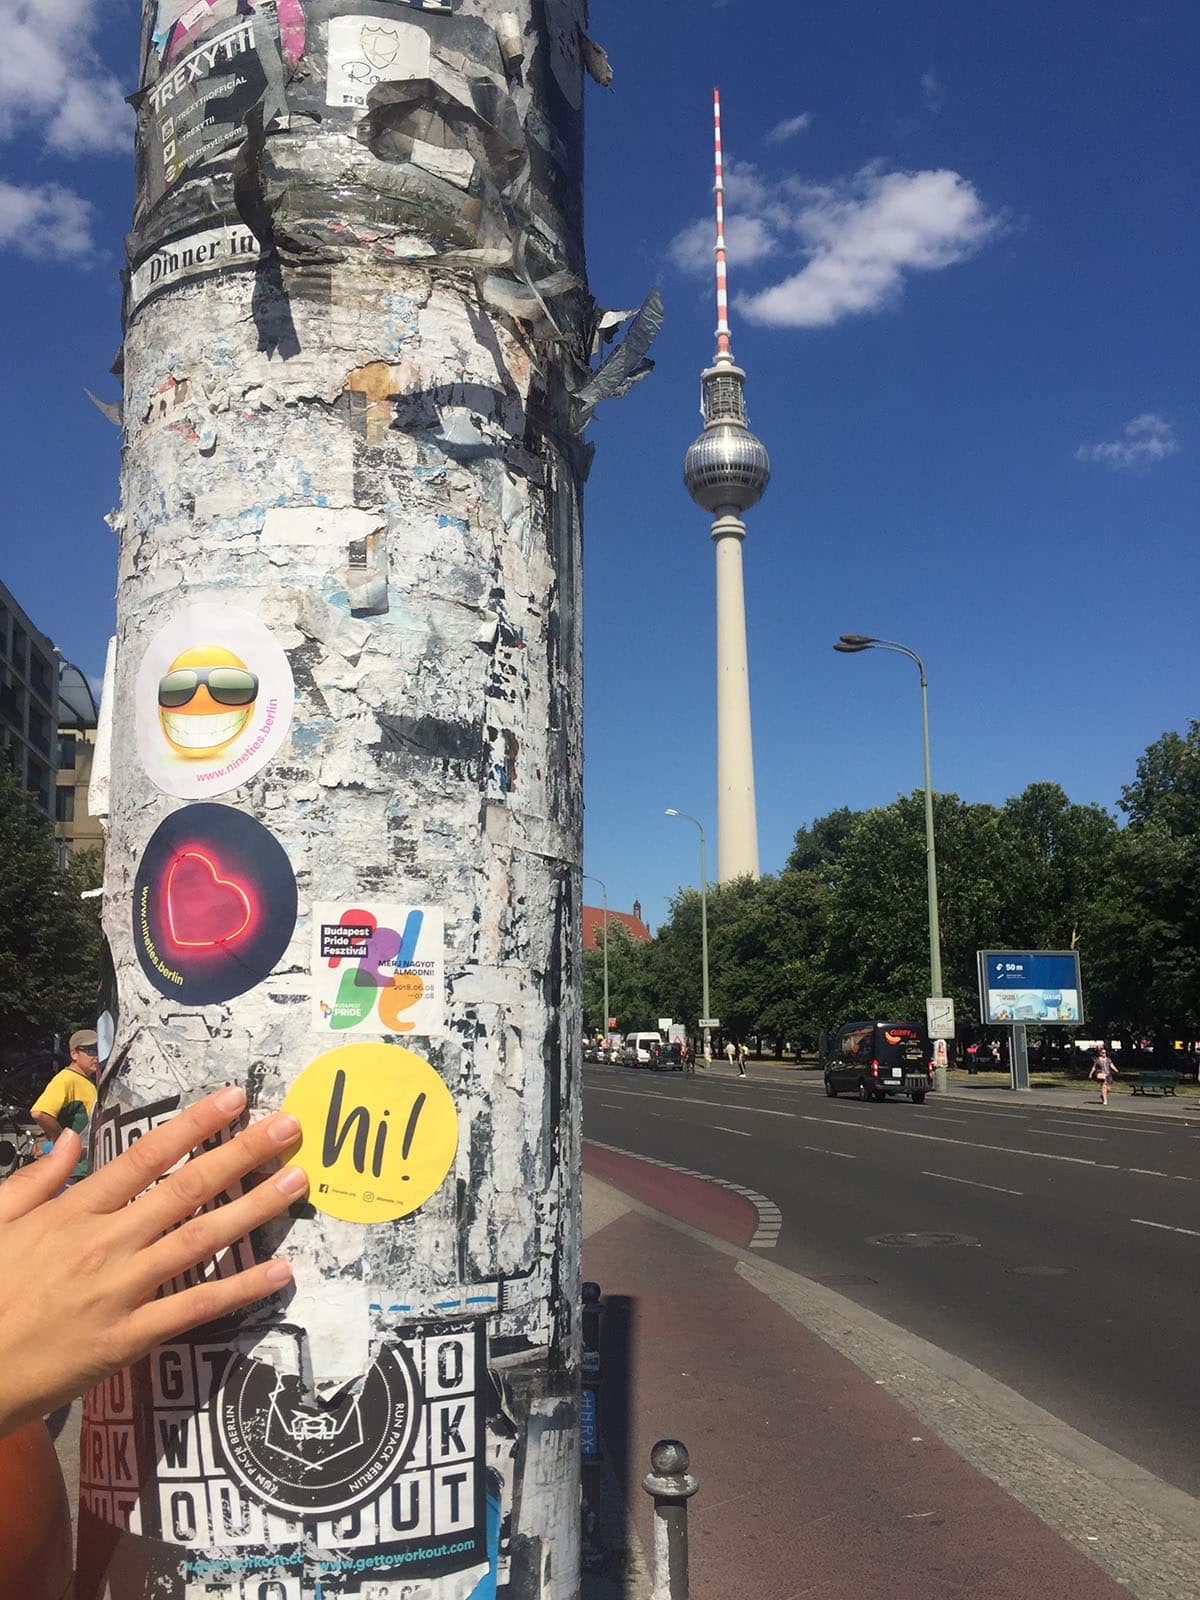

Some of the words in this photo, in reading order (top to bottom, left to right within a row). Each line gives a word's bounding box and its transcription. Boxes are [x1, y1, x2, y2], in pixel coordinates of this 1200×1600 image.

[150, 241, 220, 283] Dinner
[230, 231, 254, 255] in
[196, 698, 278, 782] www.nineties.berlin
[141, 886, 184, 985] www.nineties.berlin
[323, 926, 369, 937] Budapest
[323, 937, 349, 945] Pride
[323, 945, 367, 955] Fesztivál
[403, 960, 435, 968] NAGYOT
[1005, 963, 1016, 971] 50
[322, 1069, 427, 1181] hi!
[225, 1405, 239, 1444] BERLIN
[394, 1402, 406, 1428] RUN
[380, 1431, 401, 1462] PACK
[234, 1446, 256, 1479] PACK
[348, 1463, 384, 1492] BERLIN
[319, 1539, 475, 1571] www.gettoworkout.com
